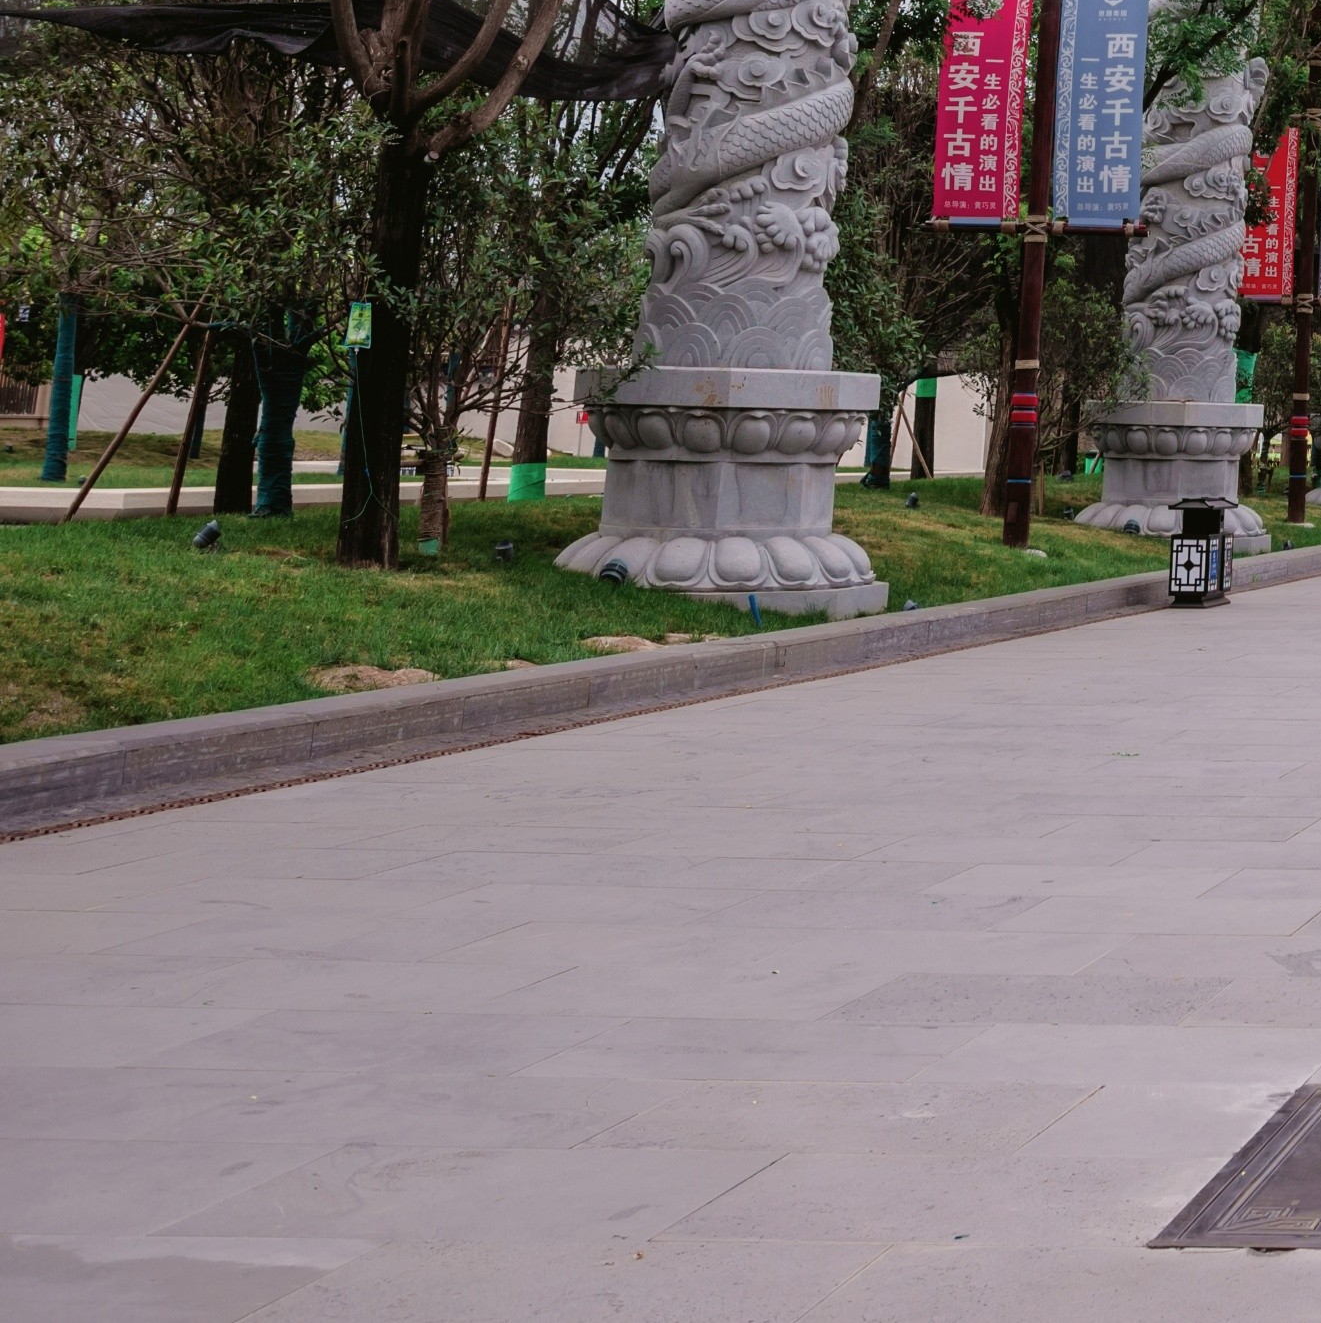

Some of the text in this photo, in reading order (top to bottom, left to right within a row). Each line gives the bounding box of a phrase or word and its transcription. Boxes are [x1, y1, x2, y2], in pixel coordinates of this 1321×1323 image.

[941, 31, 984, 192] 西安千古情
[978, 58, 1004, 192] 一生必看的演出
[1076, 57, 1100, 194] 一生必看的演出
[1099, 33, 1138, 193] 西安千古情
